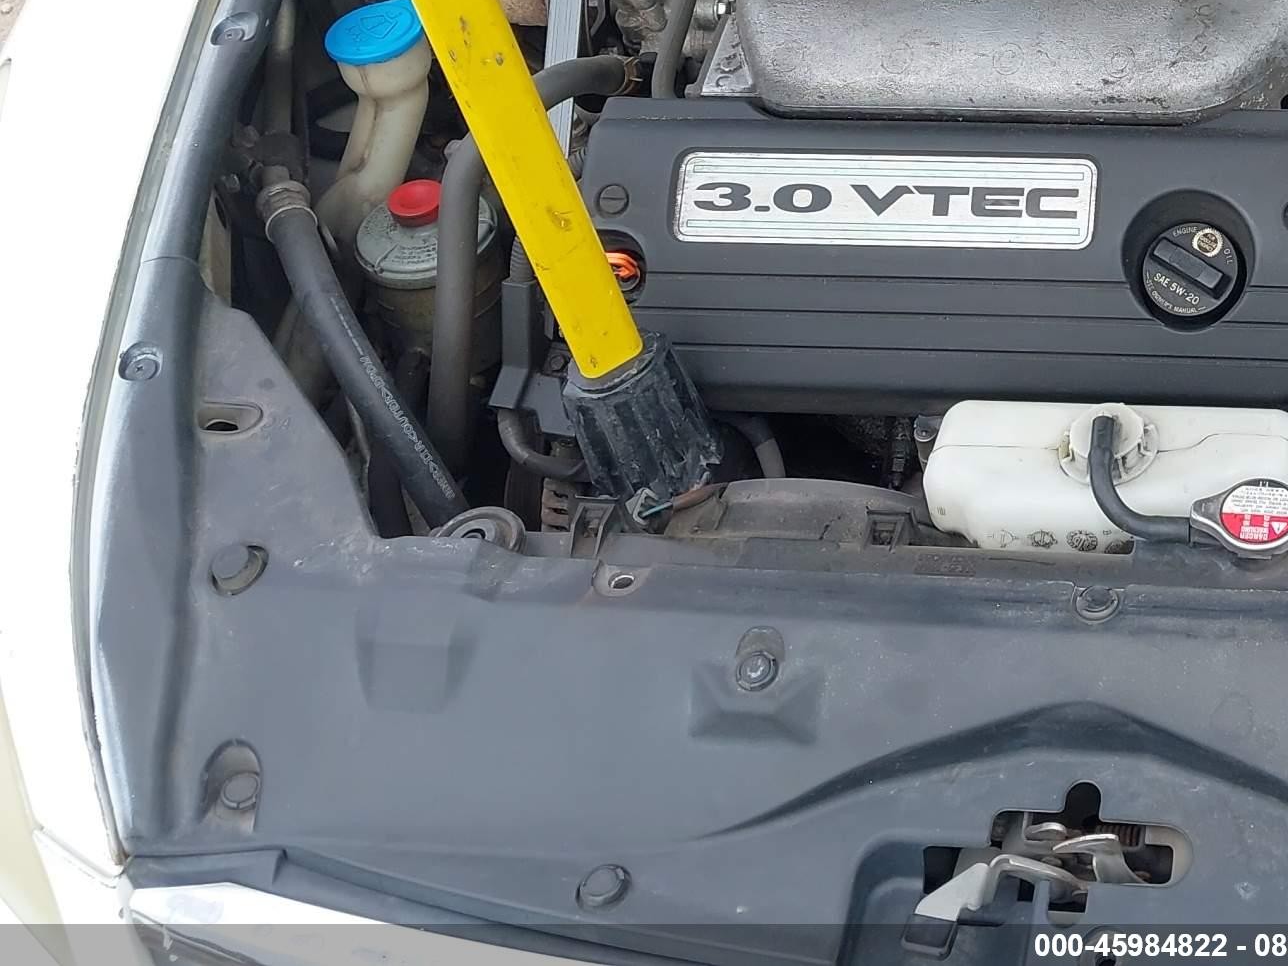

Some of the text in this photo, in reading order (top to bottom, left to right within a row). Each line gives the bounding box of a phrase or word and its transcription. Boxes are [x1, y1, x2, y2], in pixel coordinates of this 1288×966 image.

[695, 181, 1079, 219] 3.0 VTEC
[1173, 226, 1233, 265] ENGINE OIL
[1153, 272, 1200, 305] SAE 5W-20
[1173, 305, 1199, 314] MANUAL
